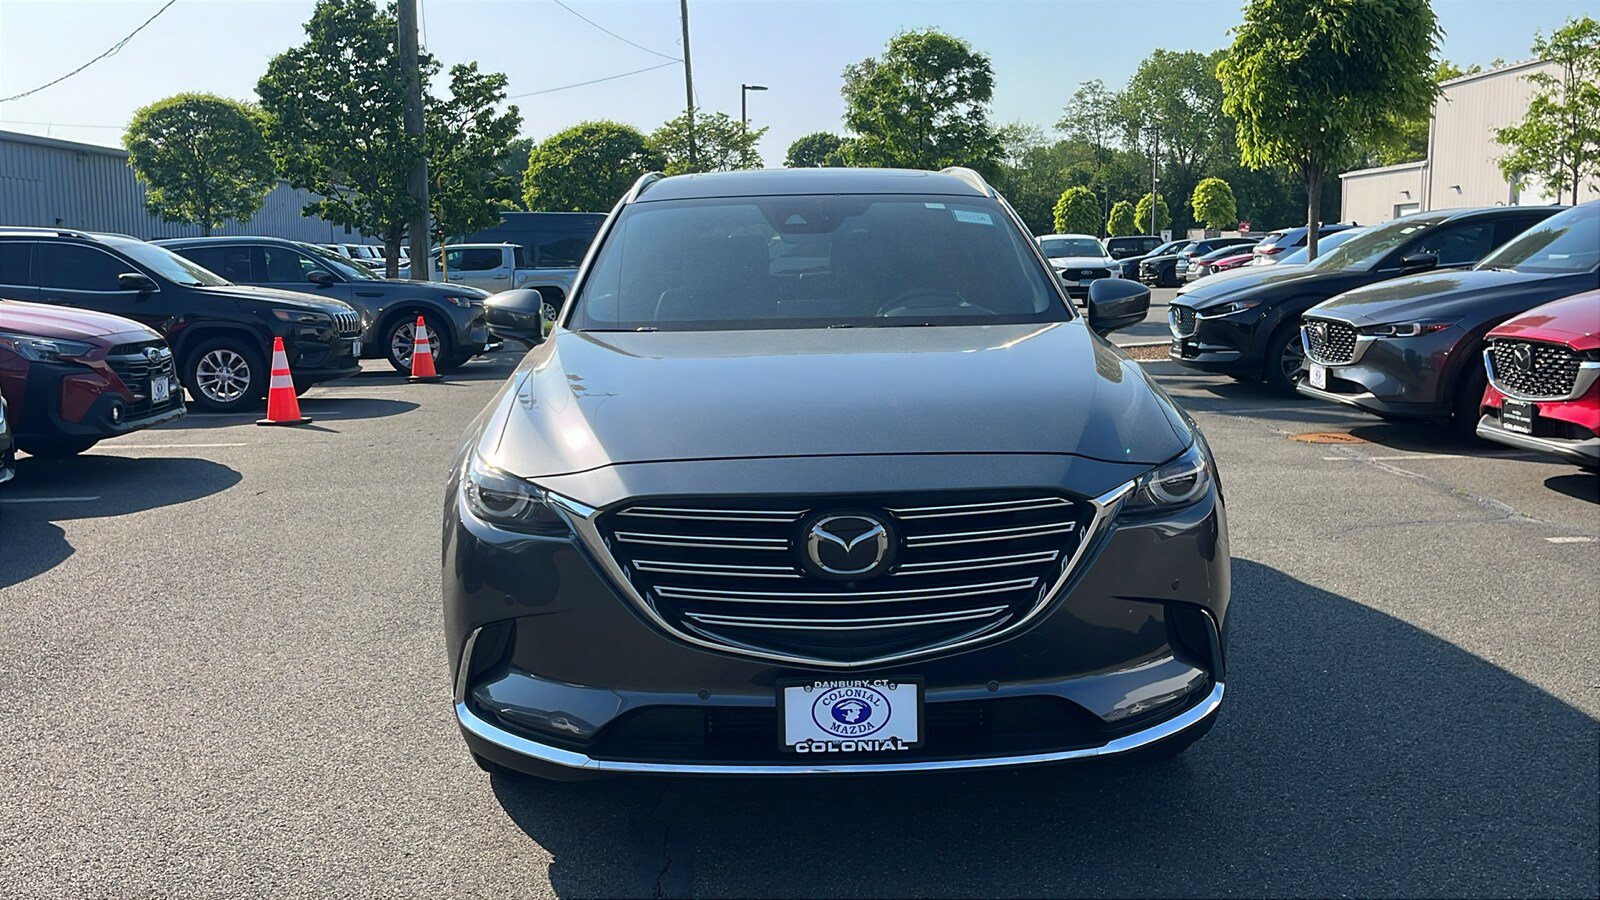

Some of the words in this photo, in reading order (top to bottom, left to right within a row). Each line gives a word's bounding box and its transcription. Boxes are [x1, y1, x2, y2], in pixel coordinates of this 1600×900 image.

[873, 679, 889, 688] CT
[822, 689, 881, 707] COLONIAL
[830, 721, 876, 735] MAZDA
[795, 740, 909, 753] COLONIAL
